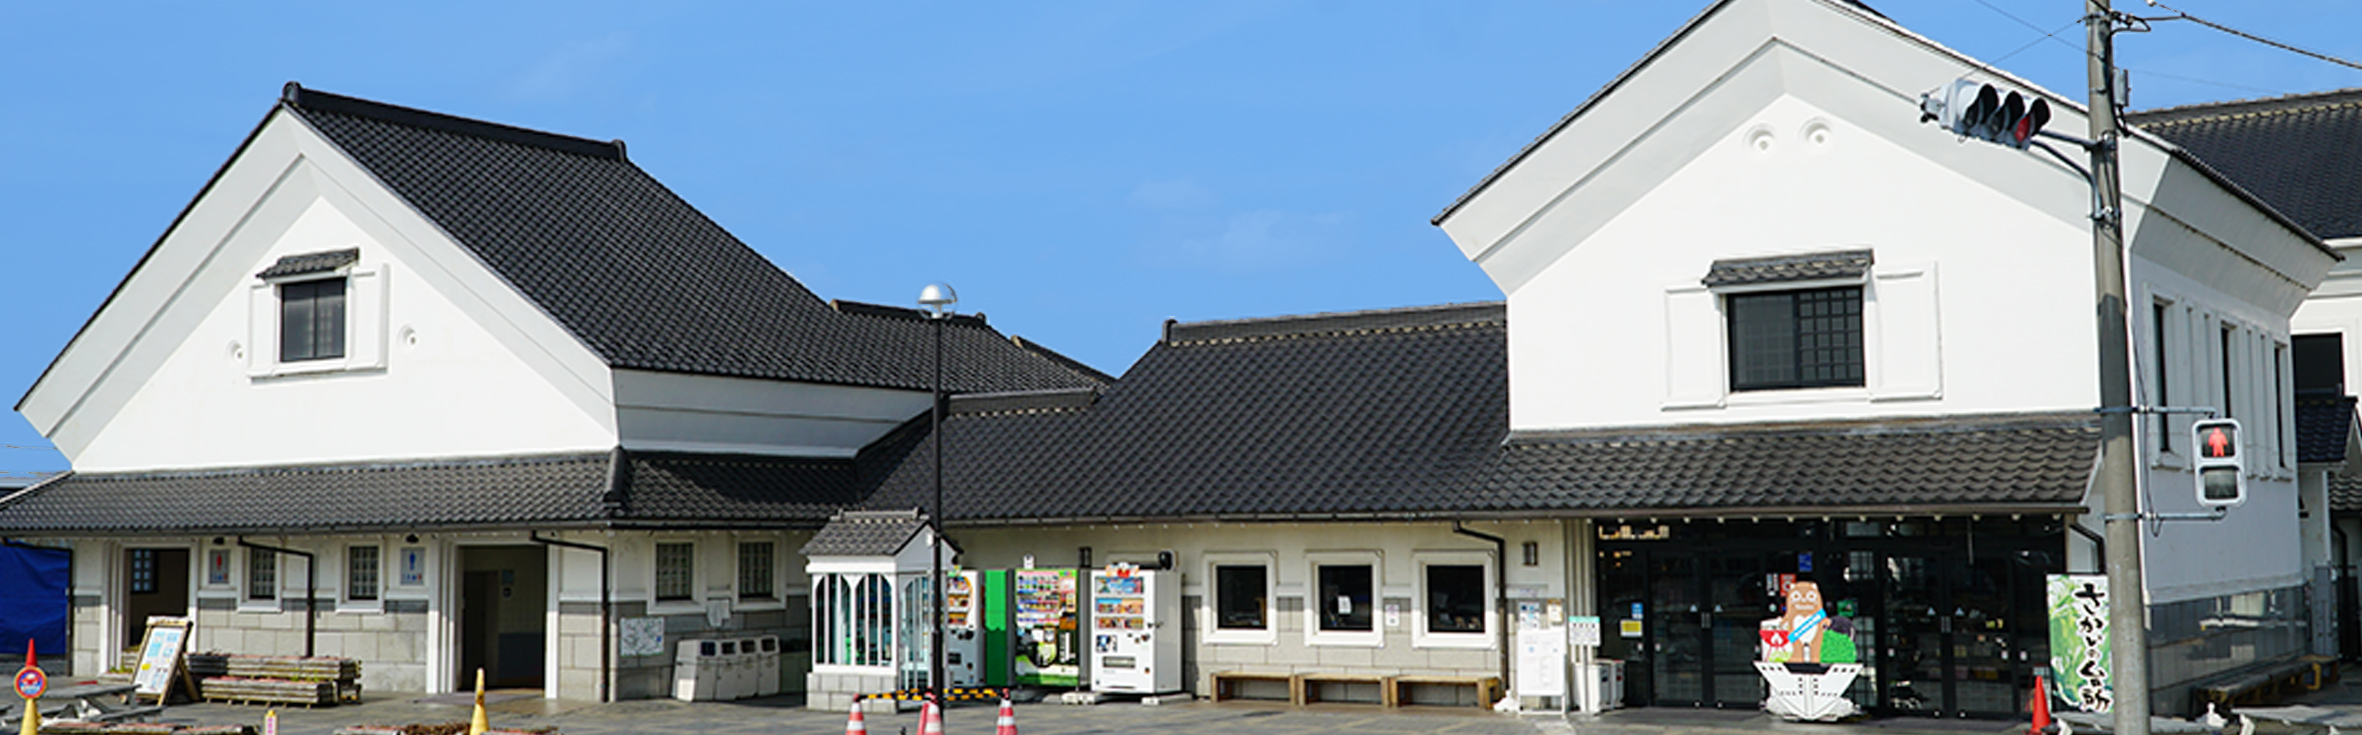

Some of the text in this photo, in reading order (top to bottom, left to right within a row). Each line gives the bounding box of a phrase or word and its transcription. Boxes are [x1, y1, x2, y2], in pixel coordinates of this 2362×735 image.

[2074, 583, 2110, 711] さかいの台所
